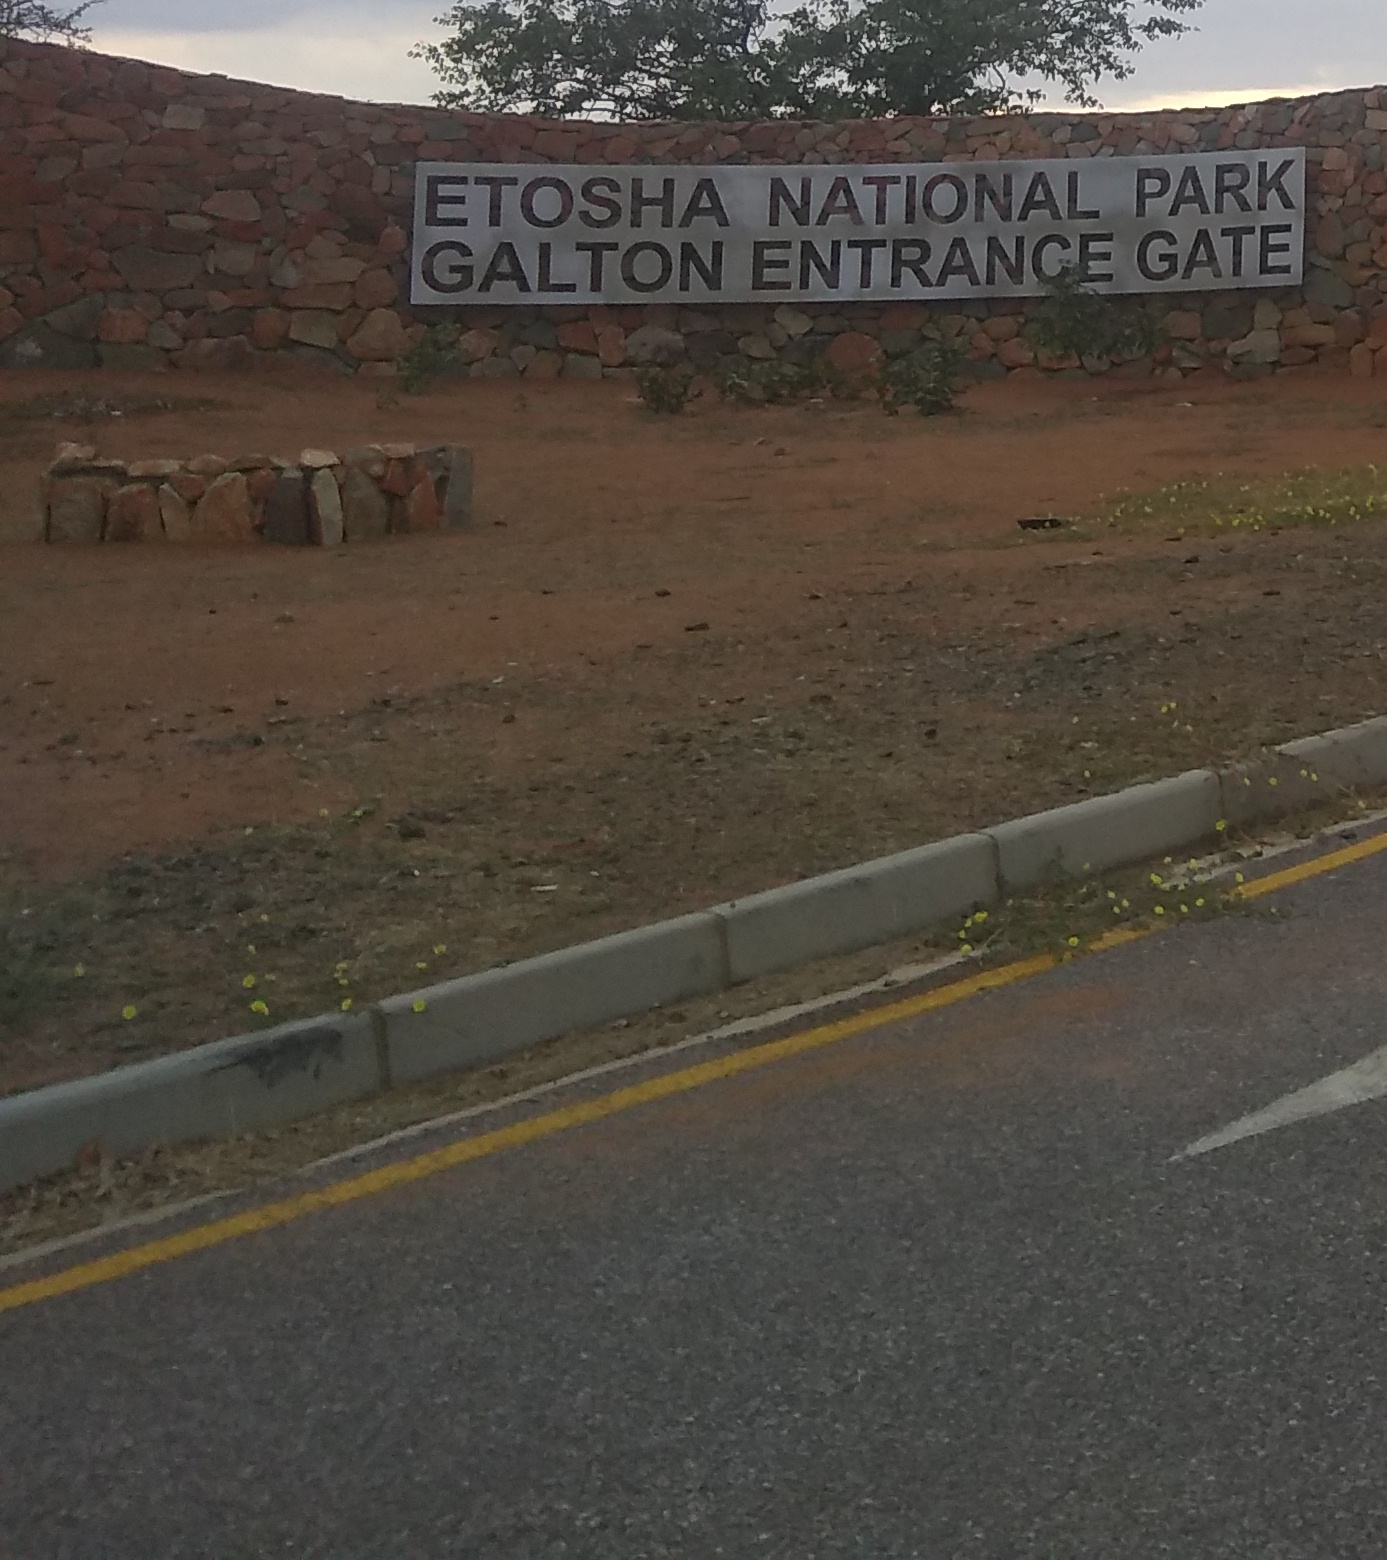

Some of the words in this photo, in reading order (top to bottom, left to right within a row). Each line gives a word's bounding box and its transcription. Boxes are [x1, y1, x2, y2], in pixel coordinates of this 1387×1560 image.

[425, 176, 730, 228] ETOSHA
[769, 170, 1100, 227] NATIONAL
[1135, 159, 1296, 220] PARK
[421, 240, 723, 293] GALTON
[752, 231, 1114, 290] ENTRANCE
[1136, 224, 1292, 280] GATE
